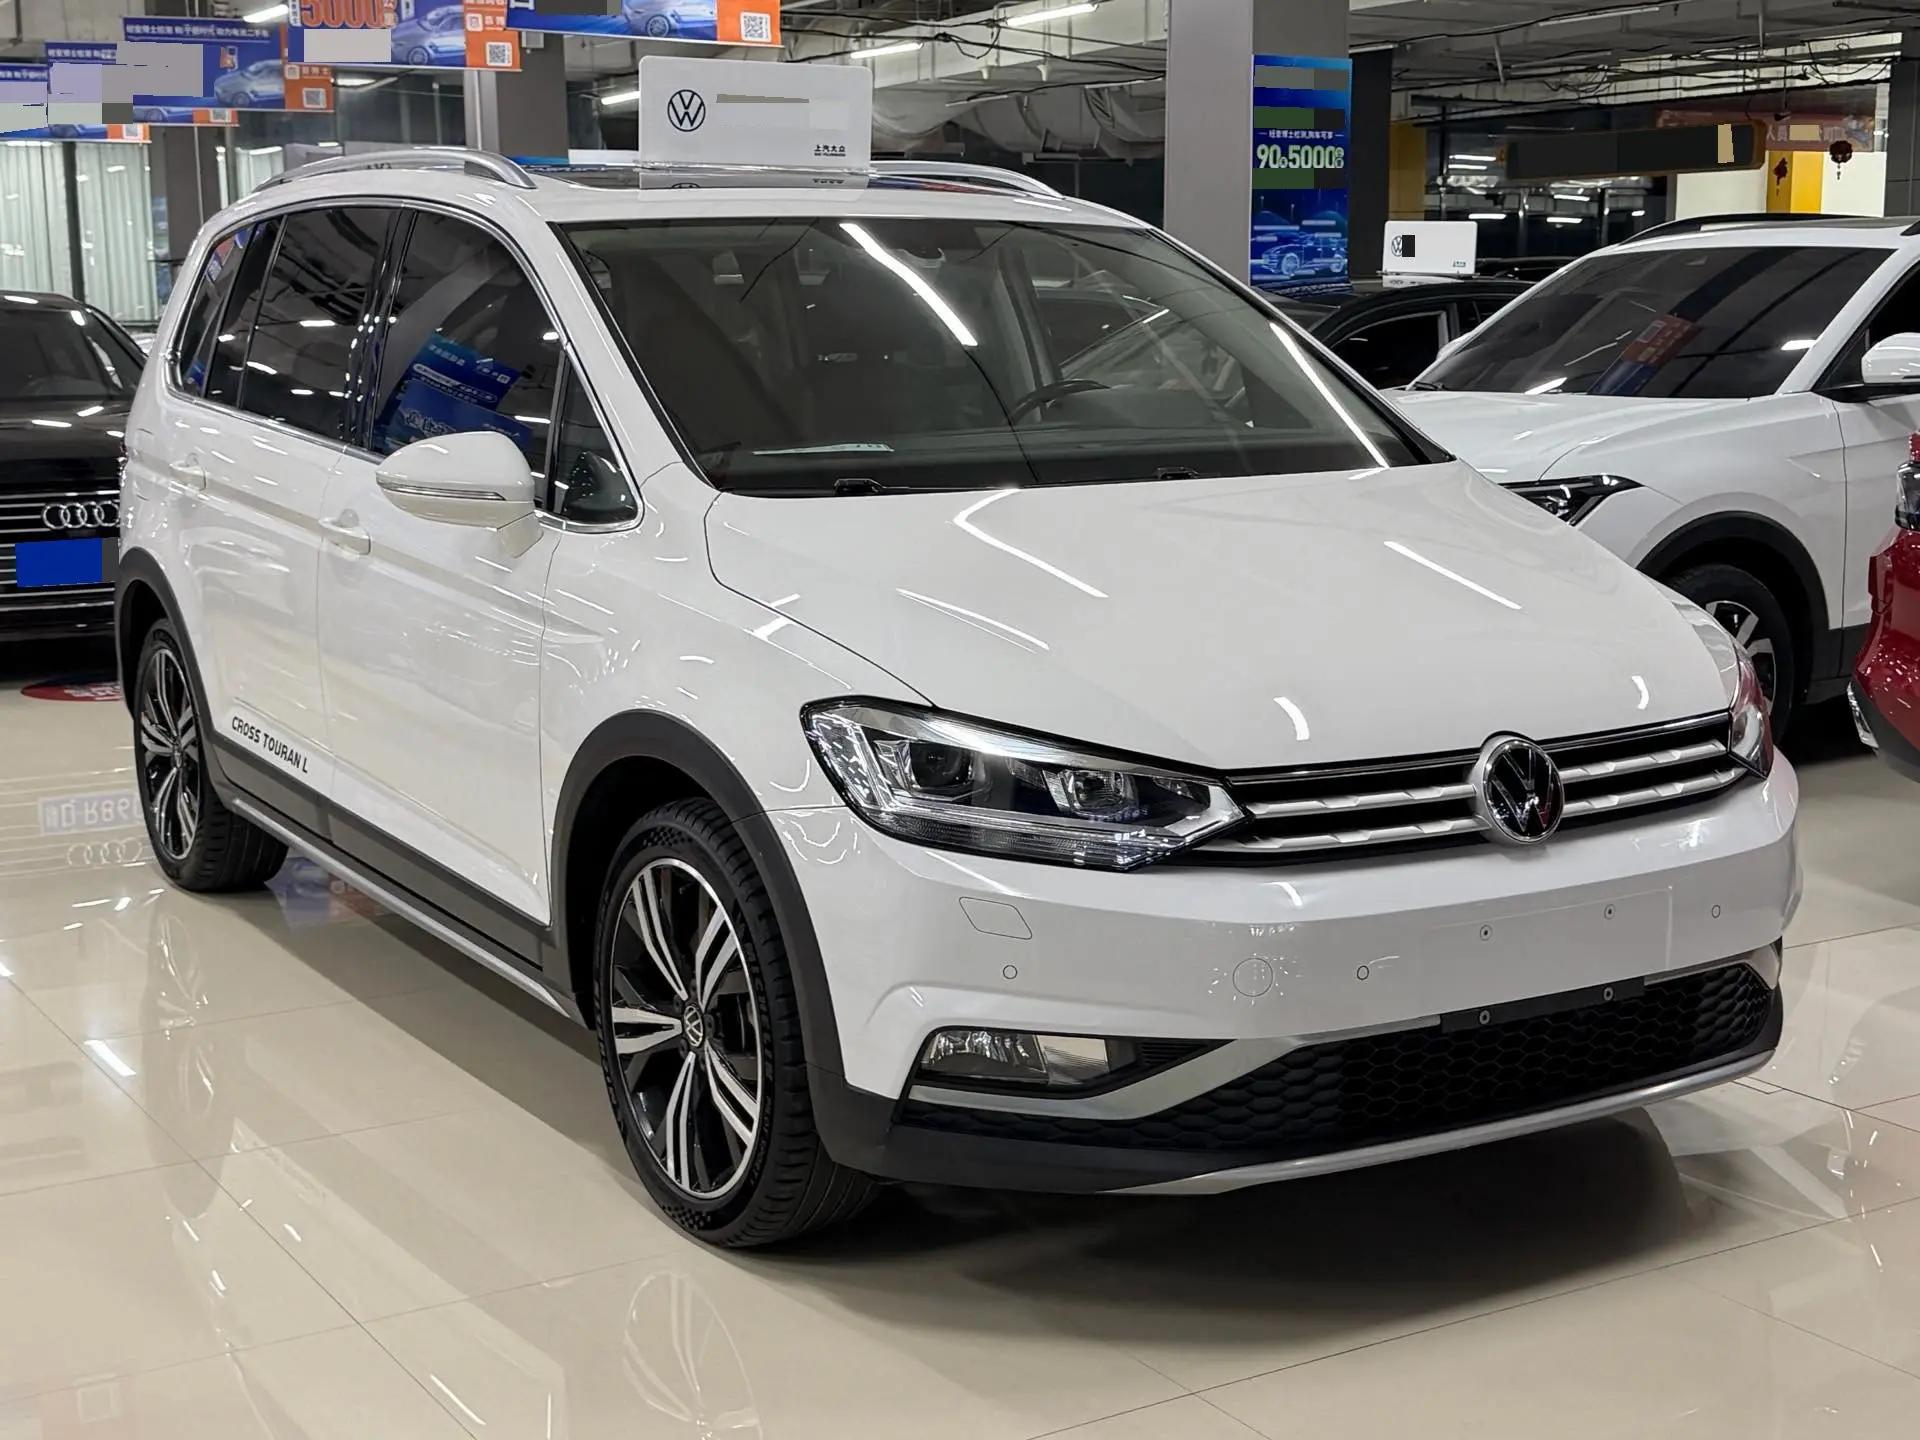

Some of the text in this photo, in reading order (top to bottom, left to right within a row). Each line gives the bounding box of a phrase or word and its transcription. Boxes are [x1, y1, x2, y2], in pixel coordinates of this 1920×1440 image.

[814, 144, 846, 153] 上汽大众
[232, 716, 308, 773] CROSS TOURAN L
